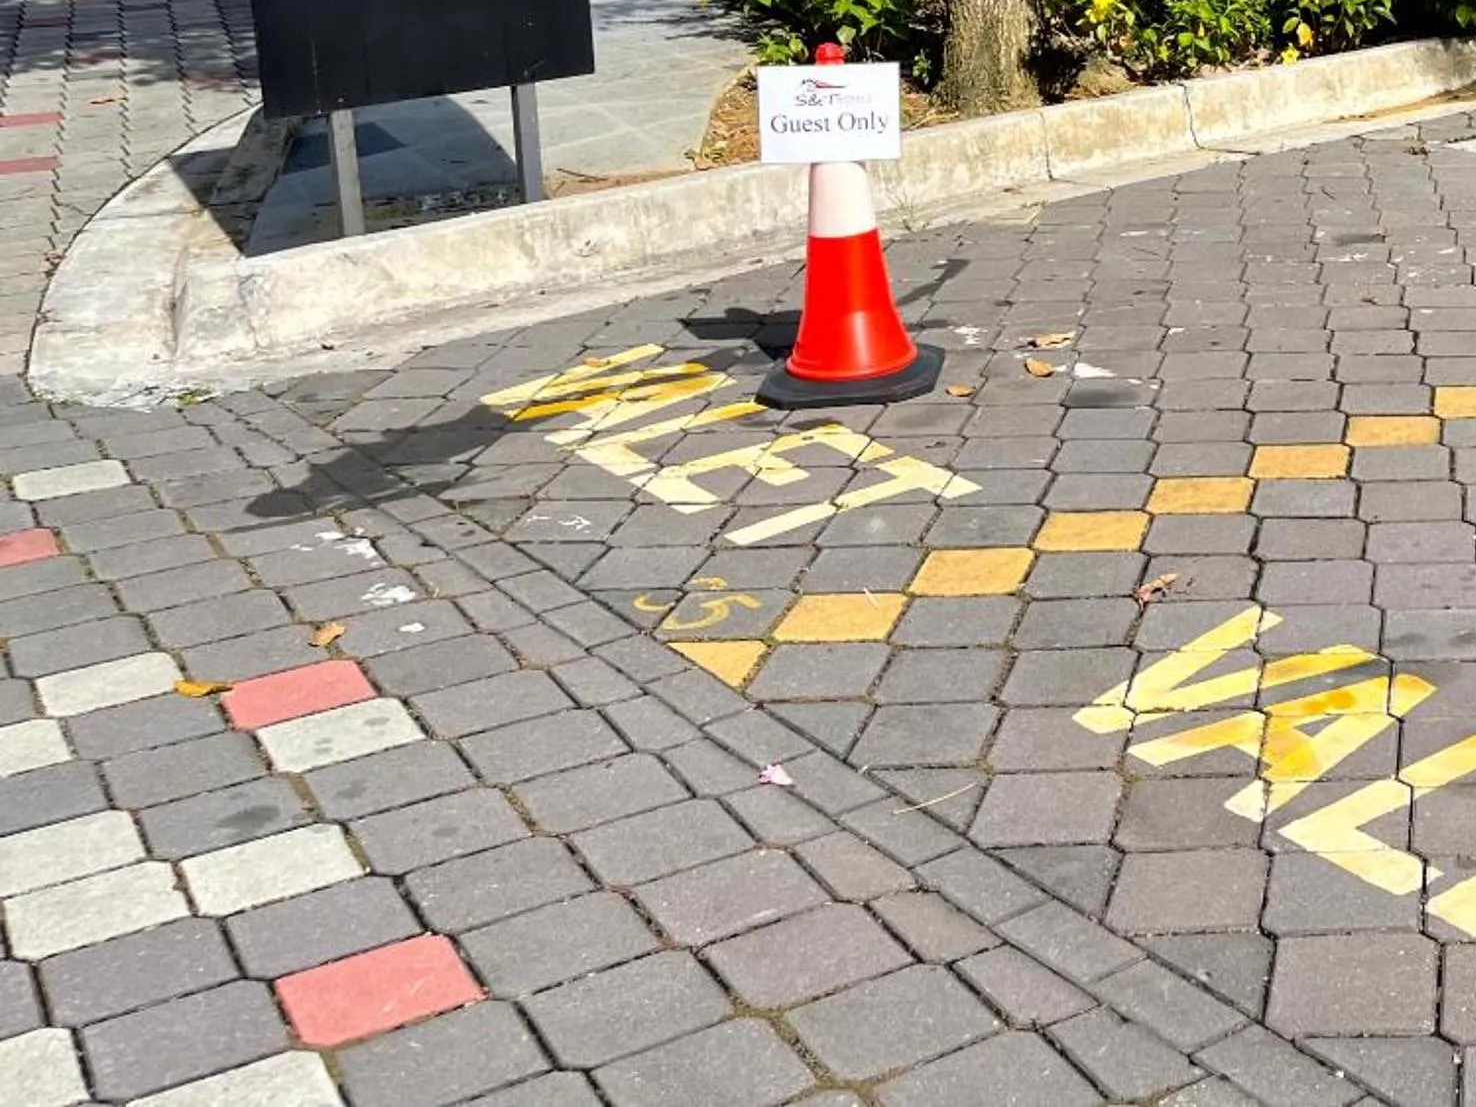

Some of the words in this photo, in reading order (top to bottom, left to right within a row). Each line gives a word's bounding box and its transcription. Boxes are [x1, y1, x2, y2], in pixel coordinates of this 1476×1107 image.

[770, 113, 831, 134] Guest
[838, 110, 889, 135] Only
[480, 342, 983, 546] VALET
